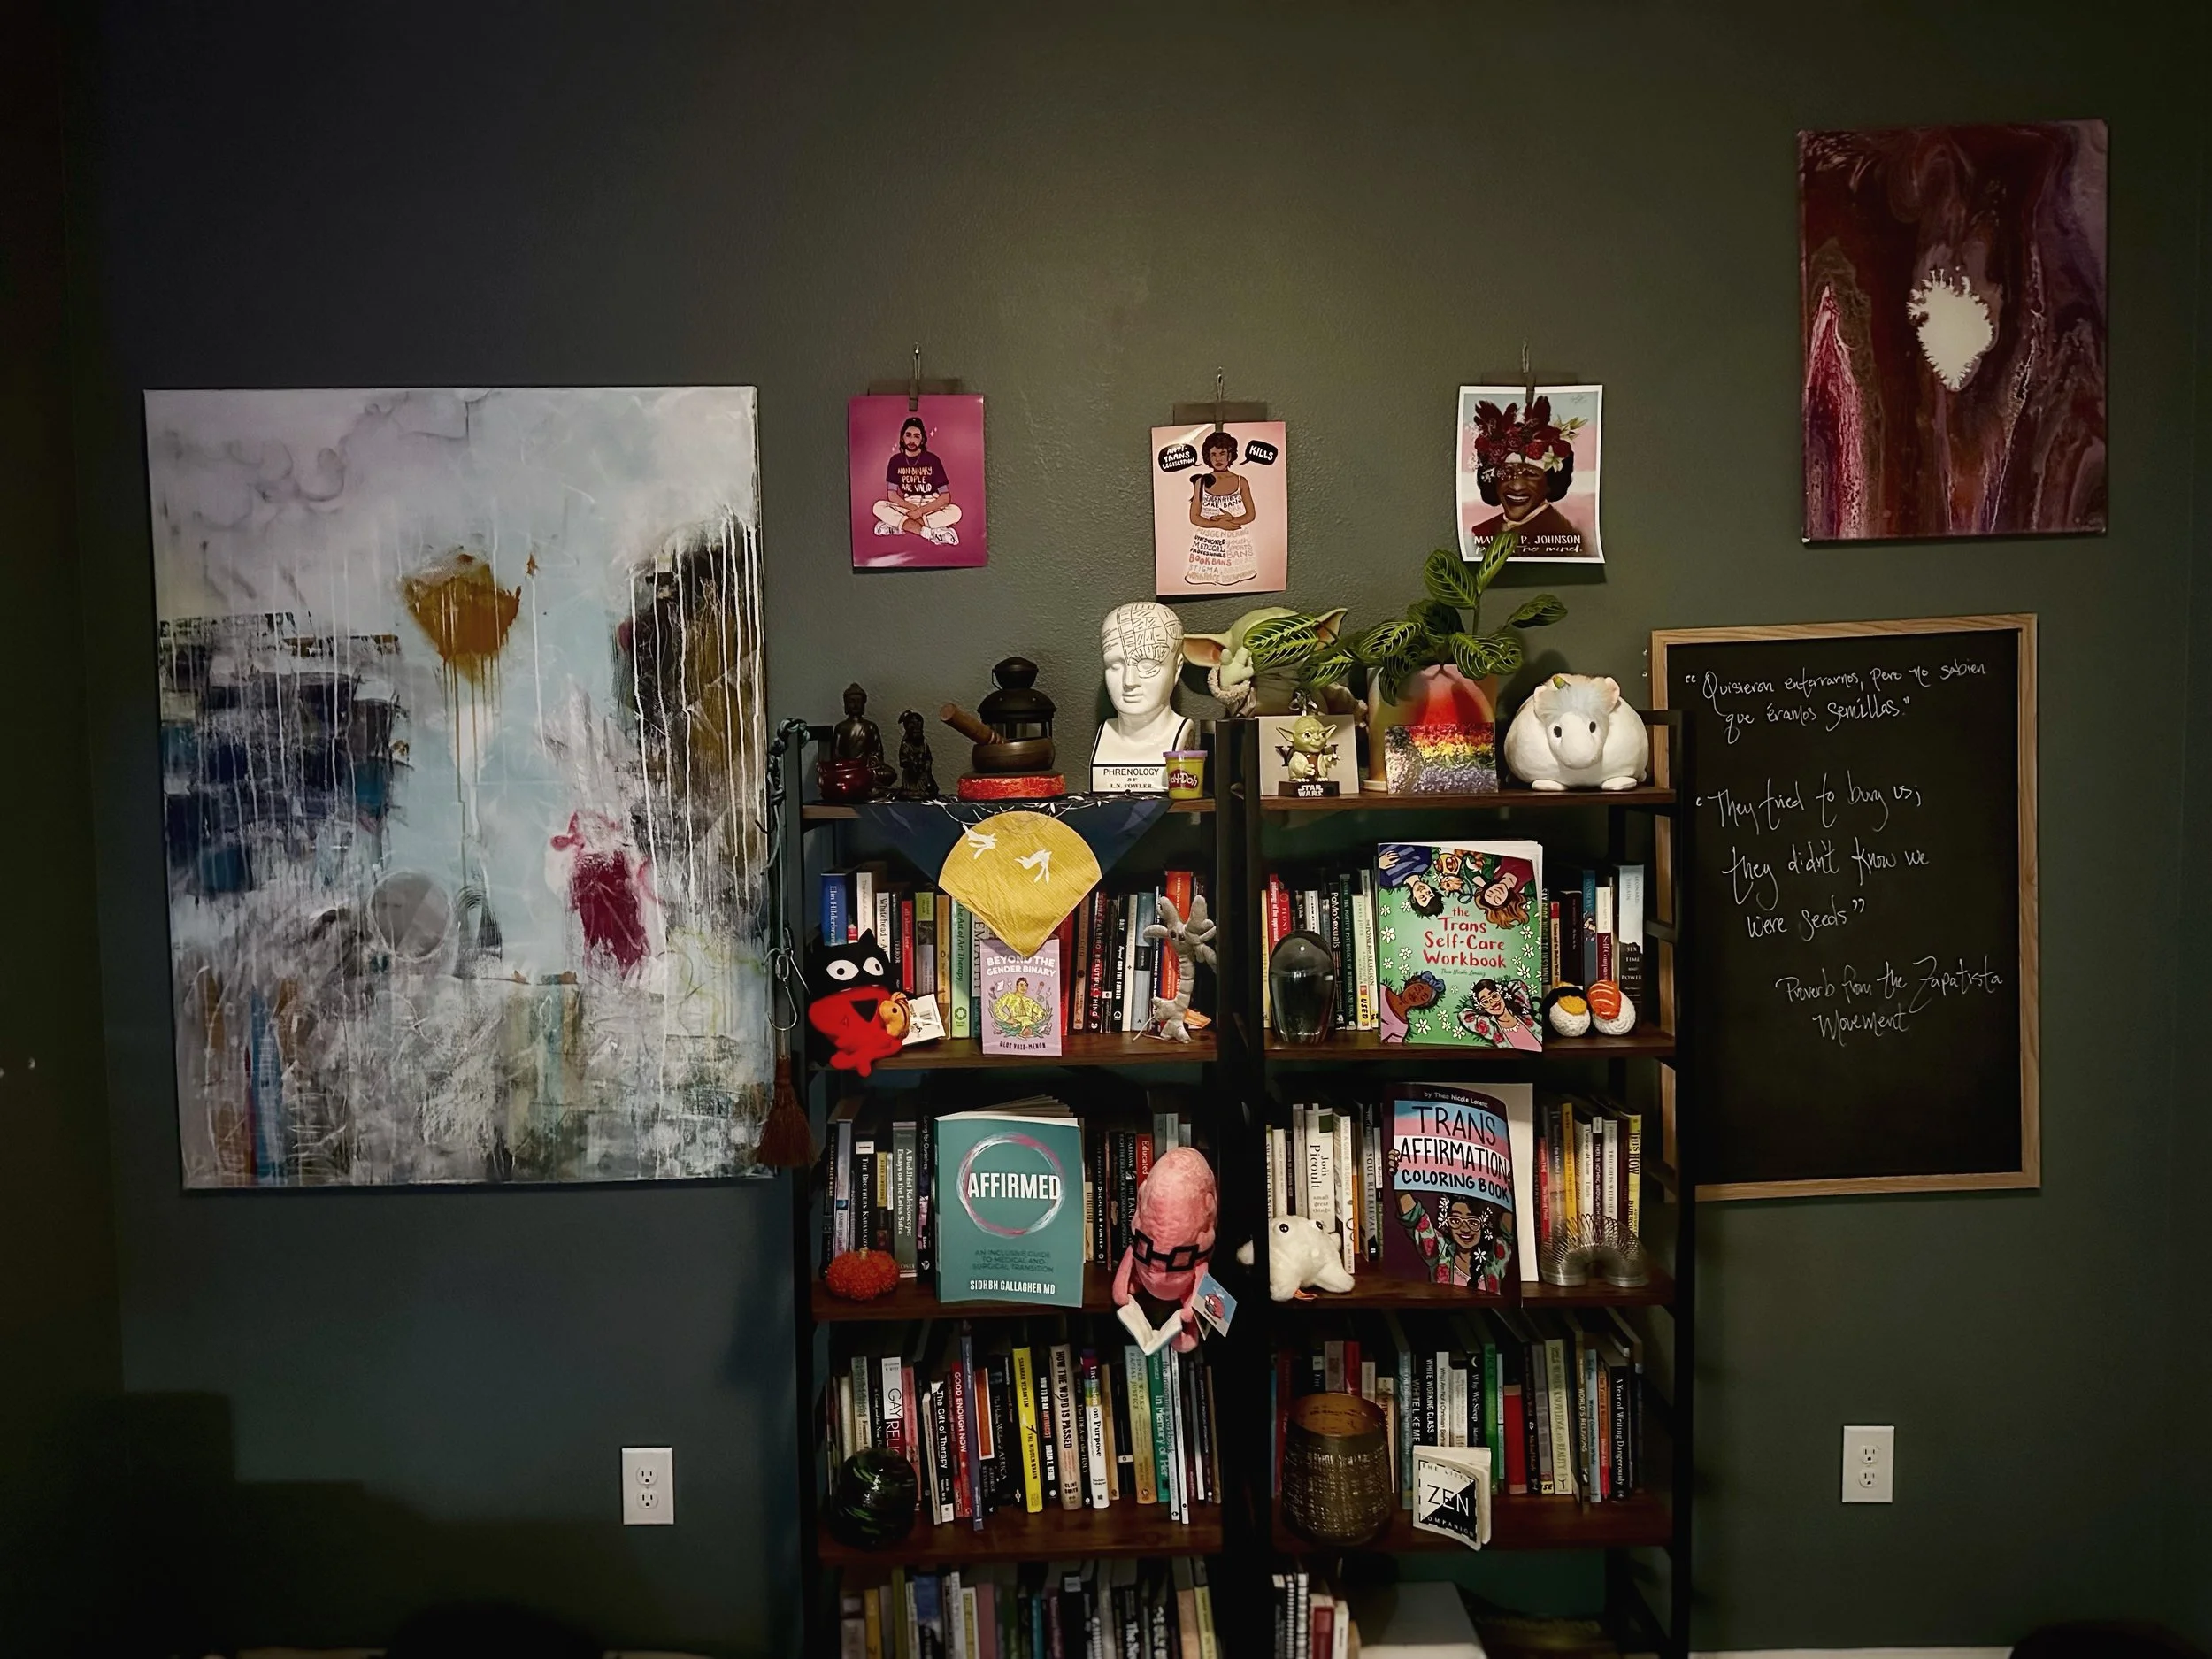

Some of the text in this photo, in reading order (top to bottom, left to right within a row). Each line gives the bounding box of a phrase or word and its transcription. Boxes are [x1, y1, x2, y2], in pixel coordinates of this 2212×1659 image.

[1163, 451, 1190, 462] TRANS
[1248, 445, 1274, 460] KILLS
[902, 475, 926, 484] PEOPLE
[914, 483, 933, 493] VALID
[1223, 498, 1242, 509] BANS
[1192, 541, 1225, 552] MEDICAL
[1520, 534, 1581, 545] P. JOHNSON
[1189, 553, 1210, 565] BOOK
[1940, 658, 1986, 680] sabien
[1724, 713, 1755, 744] que
[1759, 778, 1804, 830] tried
[1816, 772, 1837, 828] to
[1722, 847, 1778, 911] they
[1851, 837, 1896, 886] know
[1904, 850, 1930, 867] we
[879, 898, 888, 936] Whitehead
[957, 904, 966, 919] The
[1330, 892, 1340, 949] PoMoSexuals
[1452, 906, 1470, 917] the
[957, 919, 966, 932] Art
[1094, 919, 1103, 950] FALEIRO
[1438, 917, 1486, 933] Trans
[957, 939, 966, 952] Art
[1425, 931, 1505, 951] Self-Care
[956, 953, 966, 983] Therapy
[974, 921, 985, 989] EMPATHY
[1033, 956, 1056, 967] THE
[1423, 949, 1507, 968] Workbook
[986, 965, 1056, 977] GENDER BINARY
[1092, 953, 1102, 993] BEAUTIFUL
[1775, 956, 2003, 1013] Proverb from the Zapatista
[1411, 1106, 1496, 1146] TRANS
[1310, 1144, 1322, 1189] Picoult
[1400, 1137, 1508, 1184] AFFIRMATION
[967, 1172, 1061, 1200] AFFIRMED
[1402, 1168, 1475, 1189] COLORING
[1479, 1177, 1509, 1203] BOOK
[1367, 1181, 1376, 1231] RETRIEVAL
[970, 1279, 1056, 1294] SIDHBH GALLAGHER MD
[888, 1388, 902, 1417] GAY
[1056, 1350, 1072, 1448] HOW THE WORD IS PASSED
[1615, 1384, 1624, 1397] Year
[954, 1371, 967, 1453] GOOD ENOUGH NOW
[1088, 1366, 1102, 1457] Inclusion on Purpose
[1614, 1412, 1624, 1440] Writing
[939, 1435, 949, 1469] Therapy
[1613, 1440, 1624, 1486] Dangerously
[1422, 1463, 1439, 1471] THE
[1427, 1484, 1469, 1517] ZEN
[1422, 1515, 1474, 1537] COMPANION
